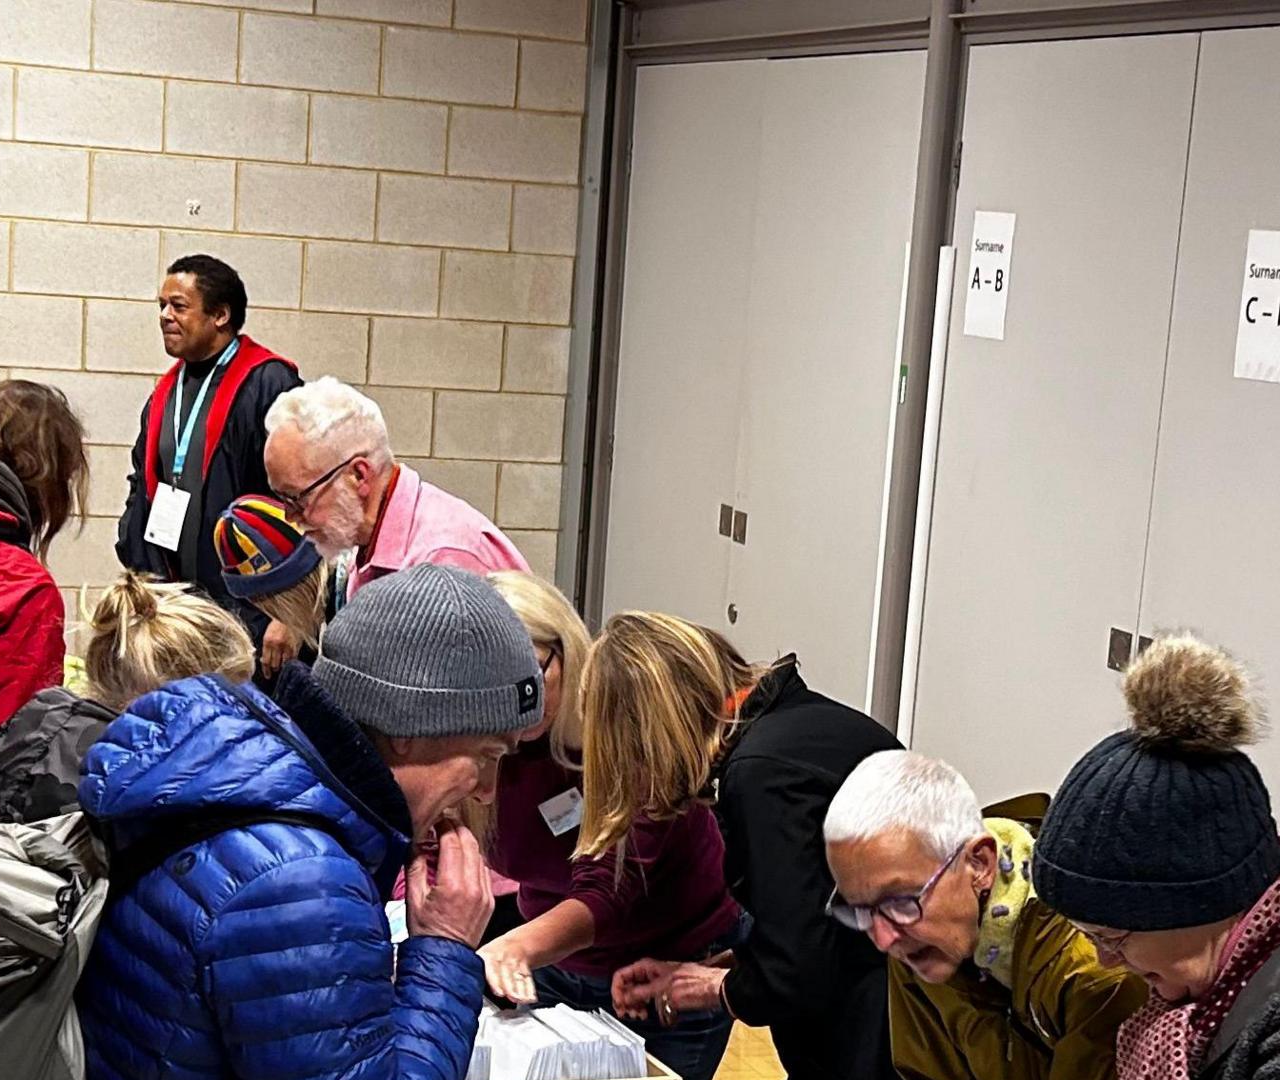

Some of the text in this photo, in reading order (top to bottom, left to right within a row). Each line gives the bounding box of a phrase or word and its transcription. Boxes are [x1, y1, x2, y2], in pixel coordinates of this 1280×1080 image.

[975, 238, 1005, 254] Surname
[971, 266, 981, 290] A
[995, 269, 1004, 292] B
[1245, 296, 1259, 324] C
